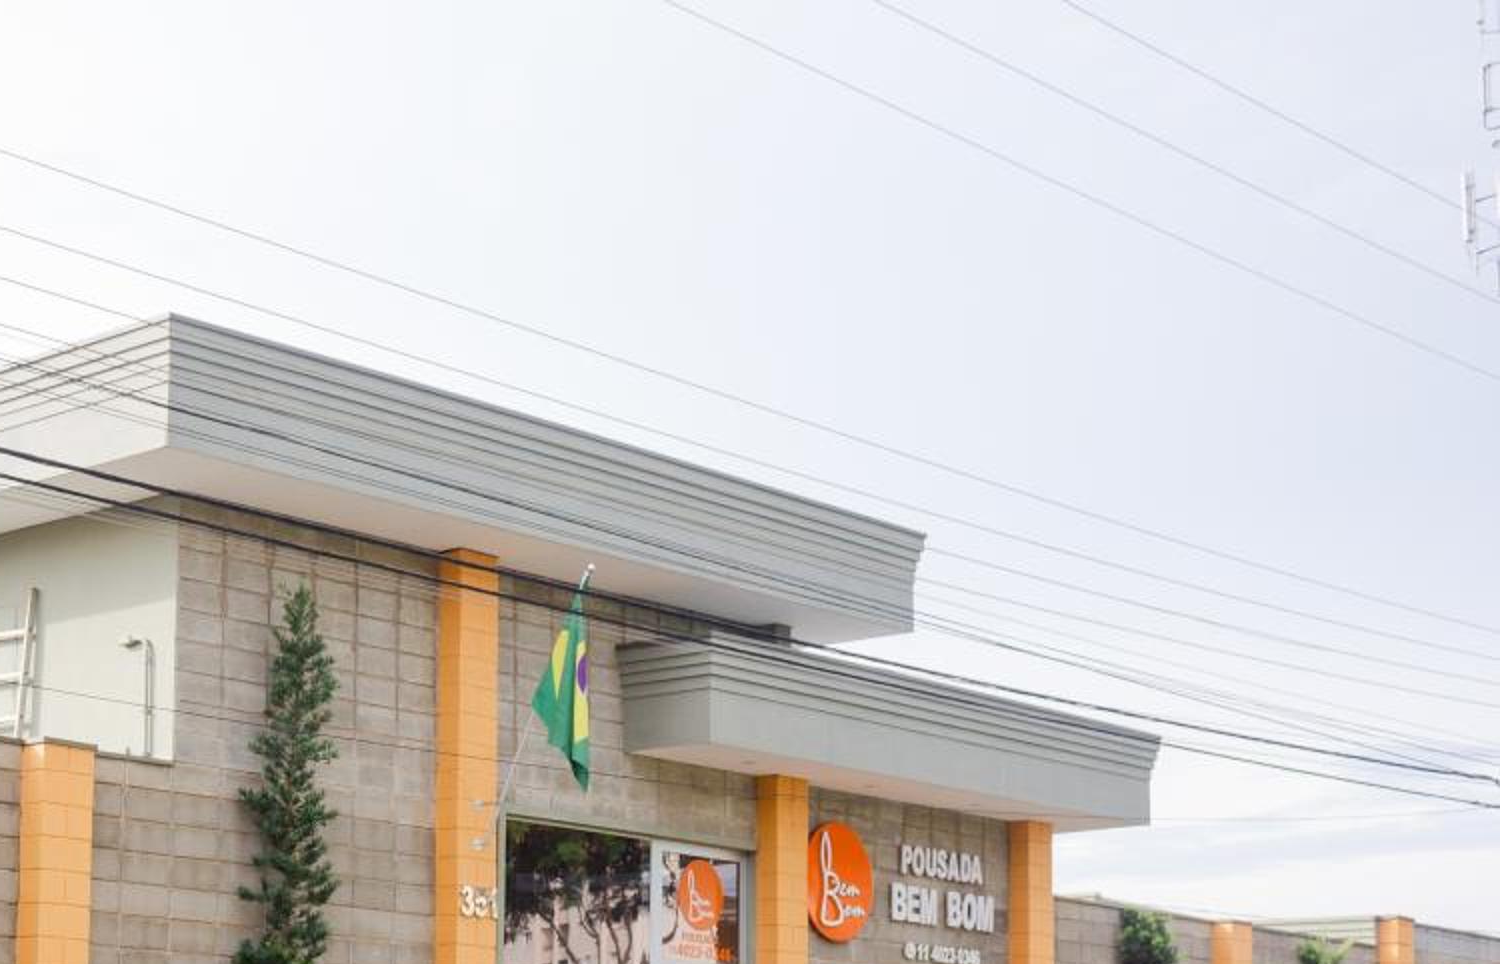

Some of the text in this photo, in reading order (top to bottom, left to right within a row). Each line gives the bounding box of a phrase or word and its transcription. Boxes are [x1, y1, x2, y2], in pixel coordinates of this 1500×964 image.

[901, 845, 983, 885] POUSADA
[891, 881, 995, 933] BEM BOM
[917, 943, 930, 961] 11
